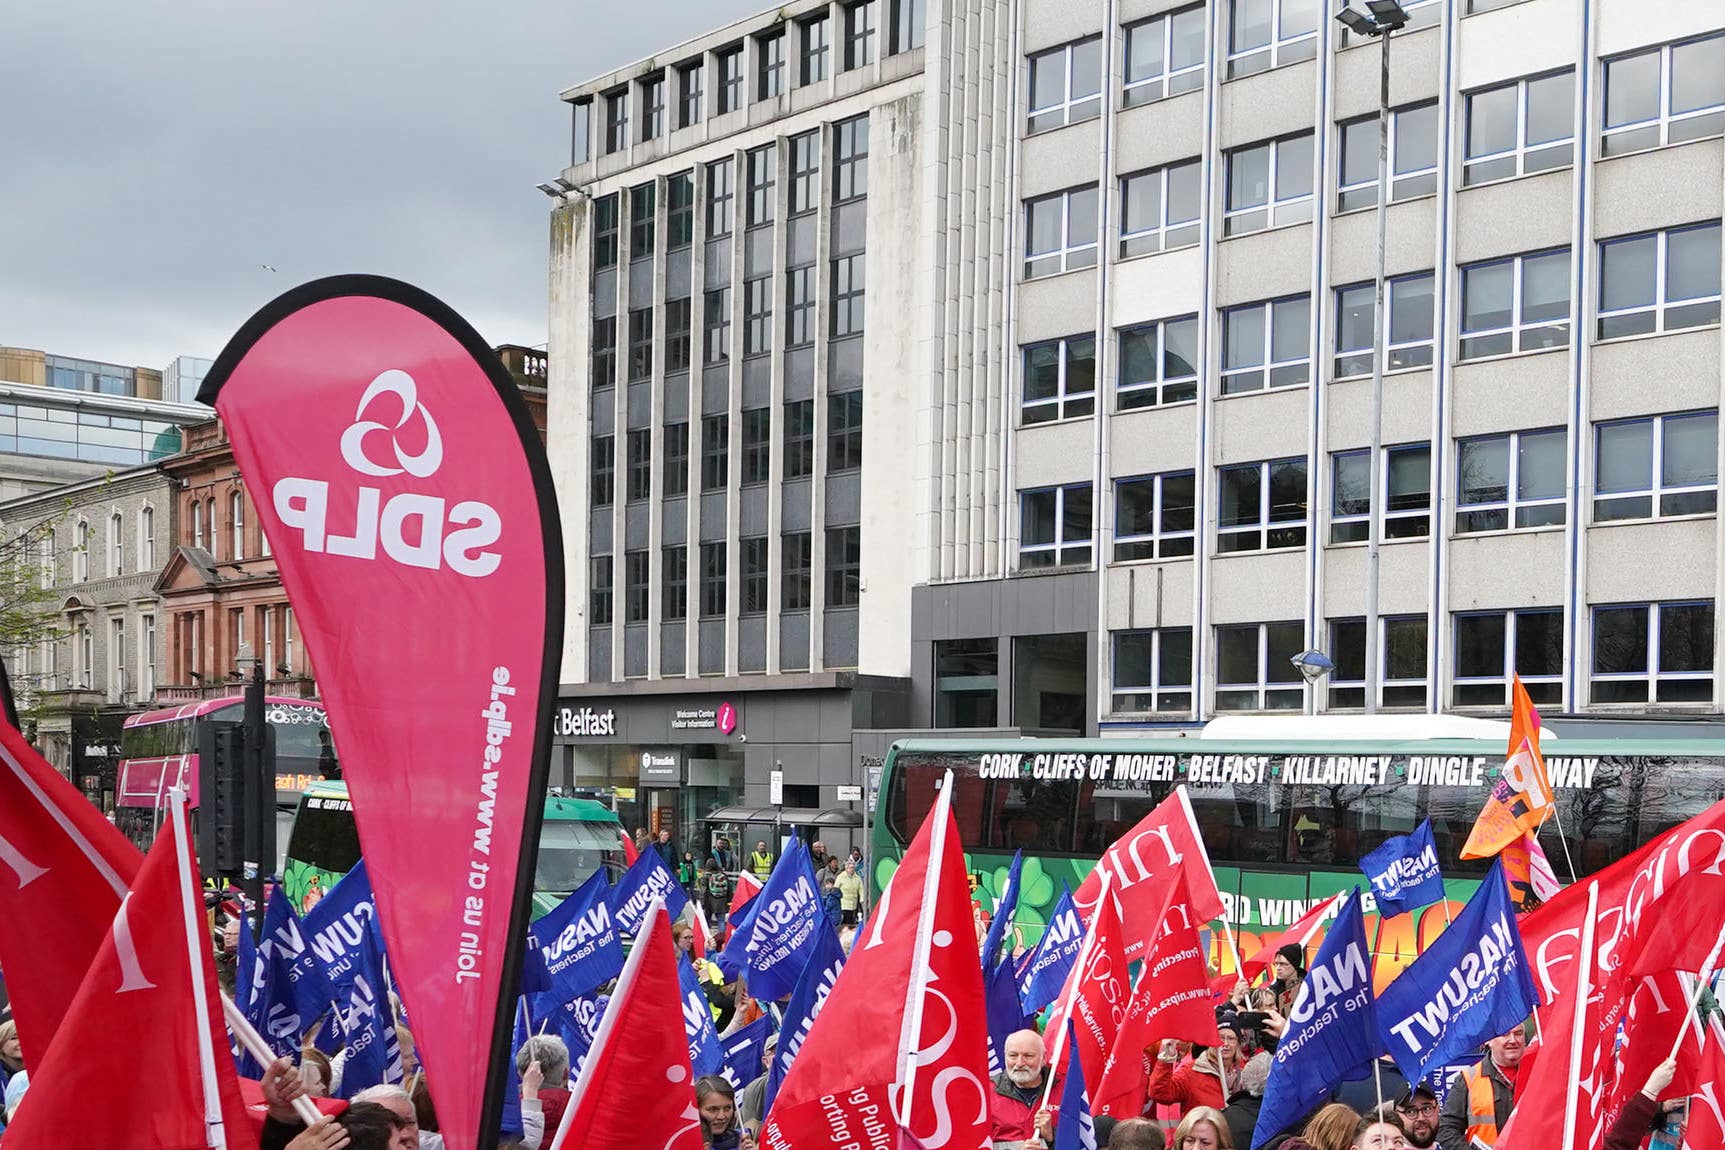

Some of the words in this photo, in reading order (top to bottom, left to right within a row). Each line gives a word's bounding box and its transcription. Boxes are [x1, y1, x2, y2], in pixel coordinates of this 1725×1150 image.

[561, 707, 616, 737] Belfast
[274, 774, 295, 790] agh
[978, 753, 1021, 780] CORK
[1033, 754, 1085, 780] CLIFFS
[1088, 754, 1110, 780] OF
[1112, 754, 1176, 782] MOHER
[1187, 755, 1269, 785] BELFAST
[1281, 756, 1392, 786] KILLARNEY
[1407, 757, 1487, 786] DINGLE
[1545, 758, 1599, 789] WAY
[819, 1092, 850, 1143] orting
[859, 1102, 891, 1150] Public
